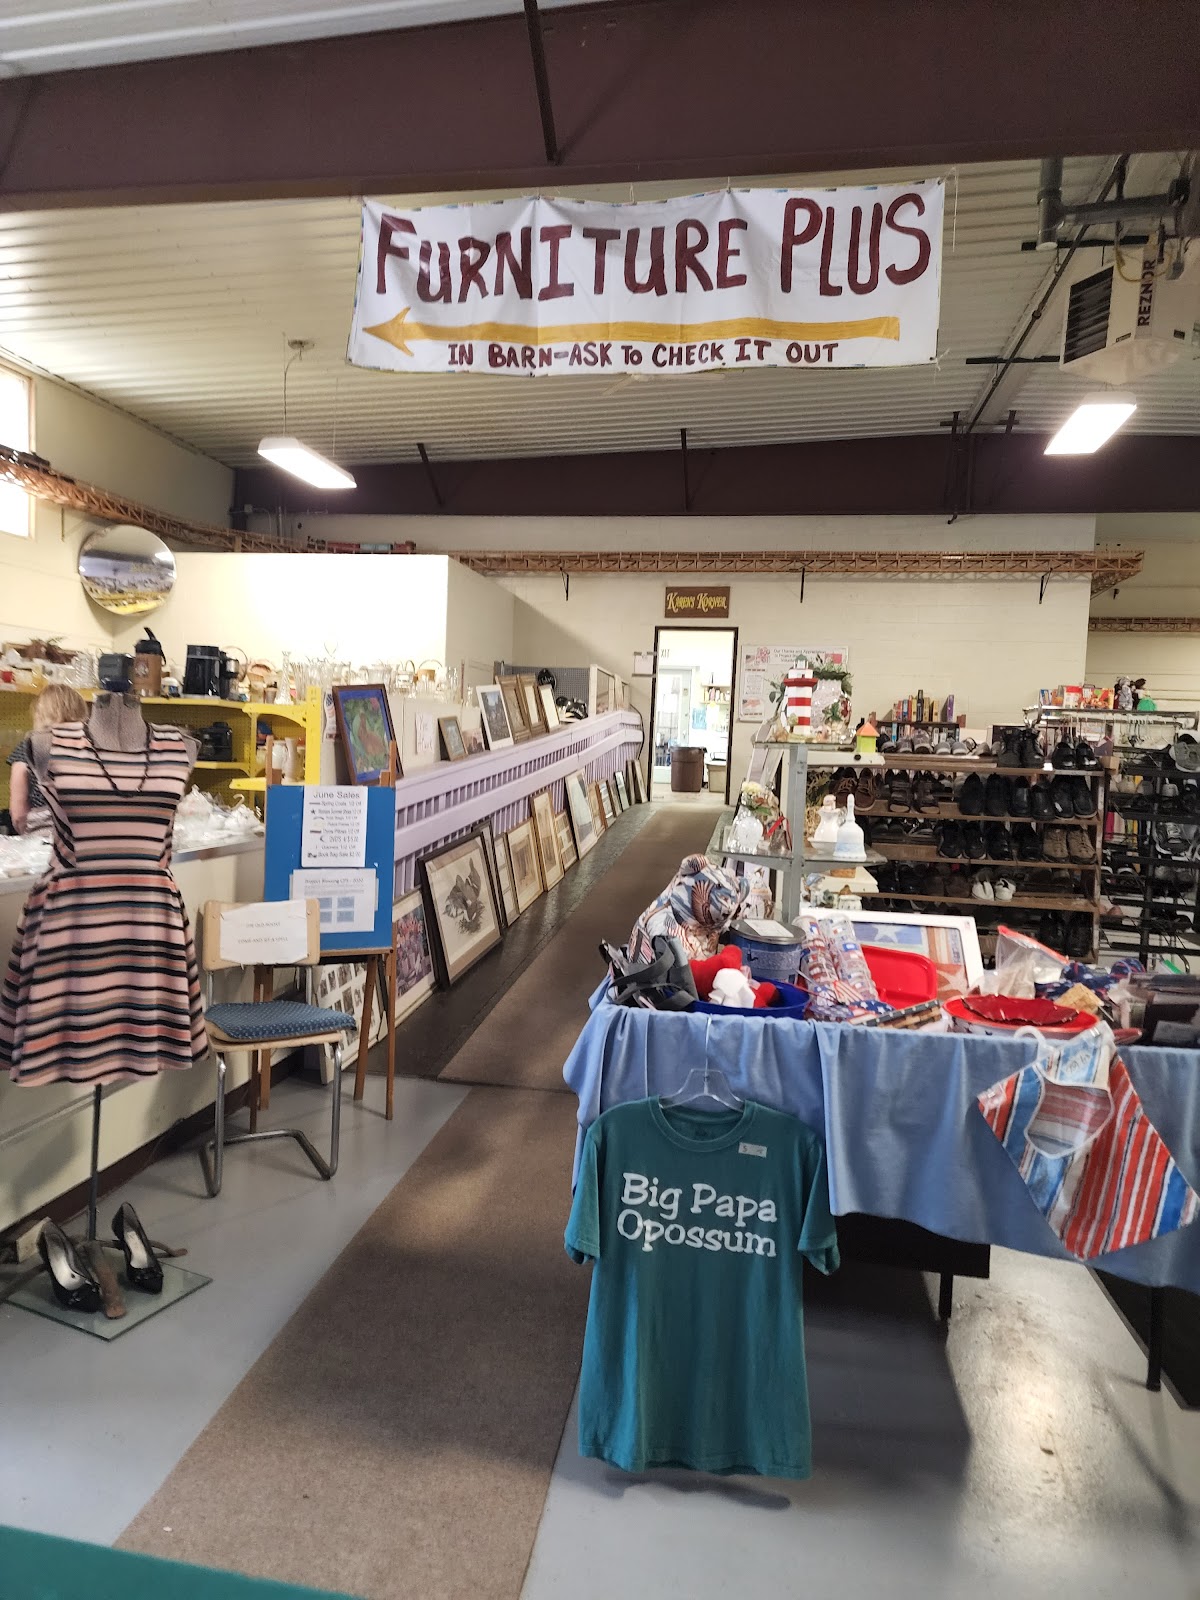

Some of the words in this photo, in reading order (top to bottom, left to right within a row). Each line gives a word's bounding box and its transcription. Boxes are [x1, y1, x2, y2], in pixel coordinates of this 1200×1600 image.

[376, 212, 748, 303] FURNITURE
[780, 193, 933, 297] PLUS
[1137, 259, 1157, 326] REZNOR
[447, 344, 474, 366] IN
[652, 343, 722, 368] CHECK
[735, 339, 772, 361] IT
[786, 343, 839, 364] OUT
[313, 791, 334, 799] June
[336, 791, 360, 799] Sales
[620, 1172, 683, 1221] Big
[689, 1183, 778, 1228] Papa
[617, 1208, 777, 1258] Opossum
